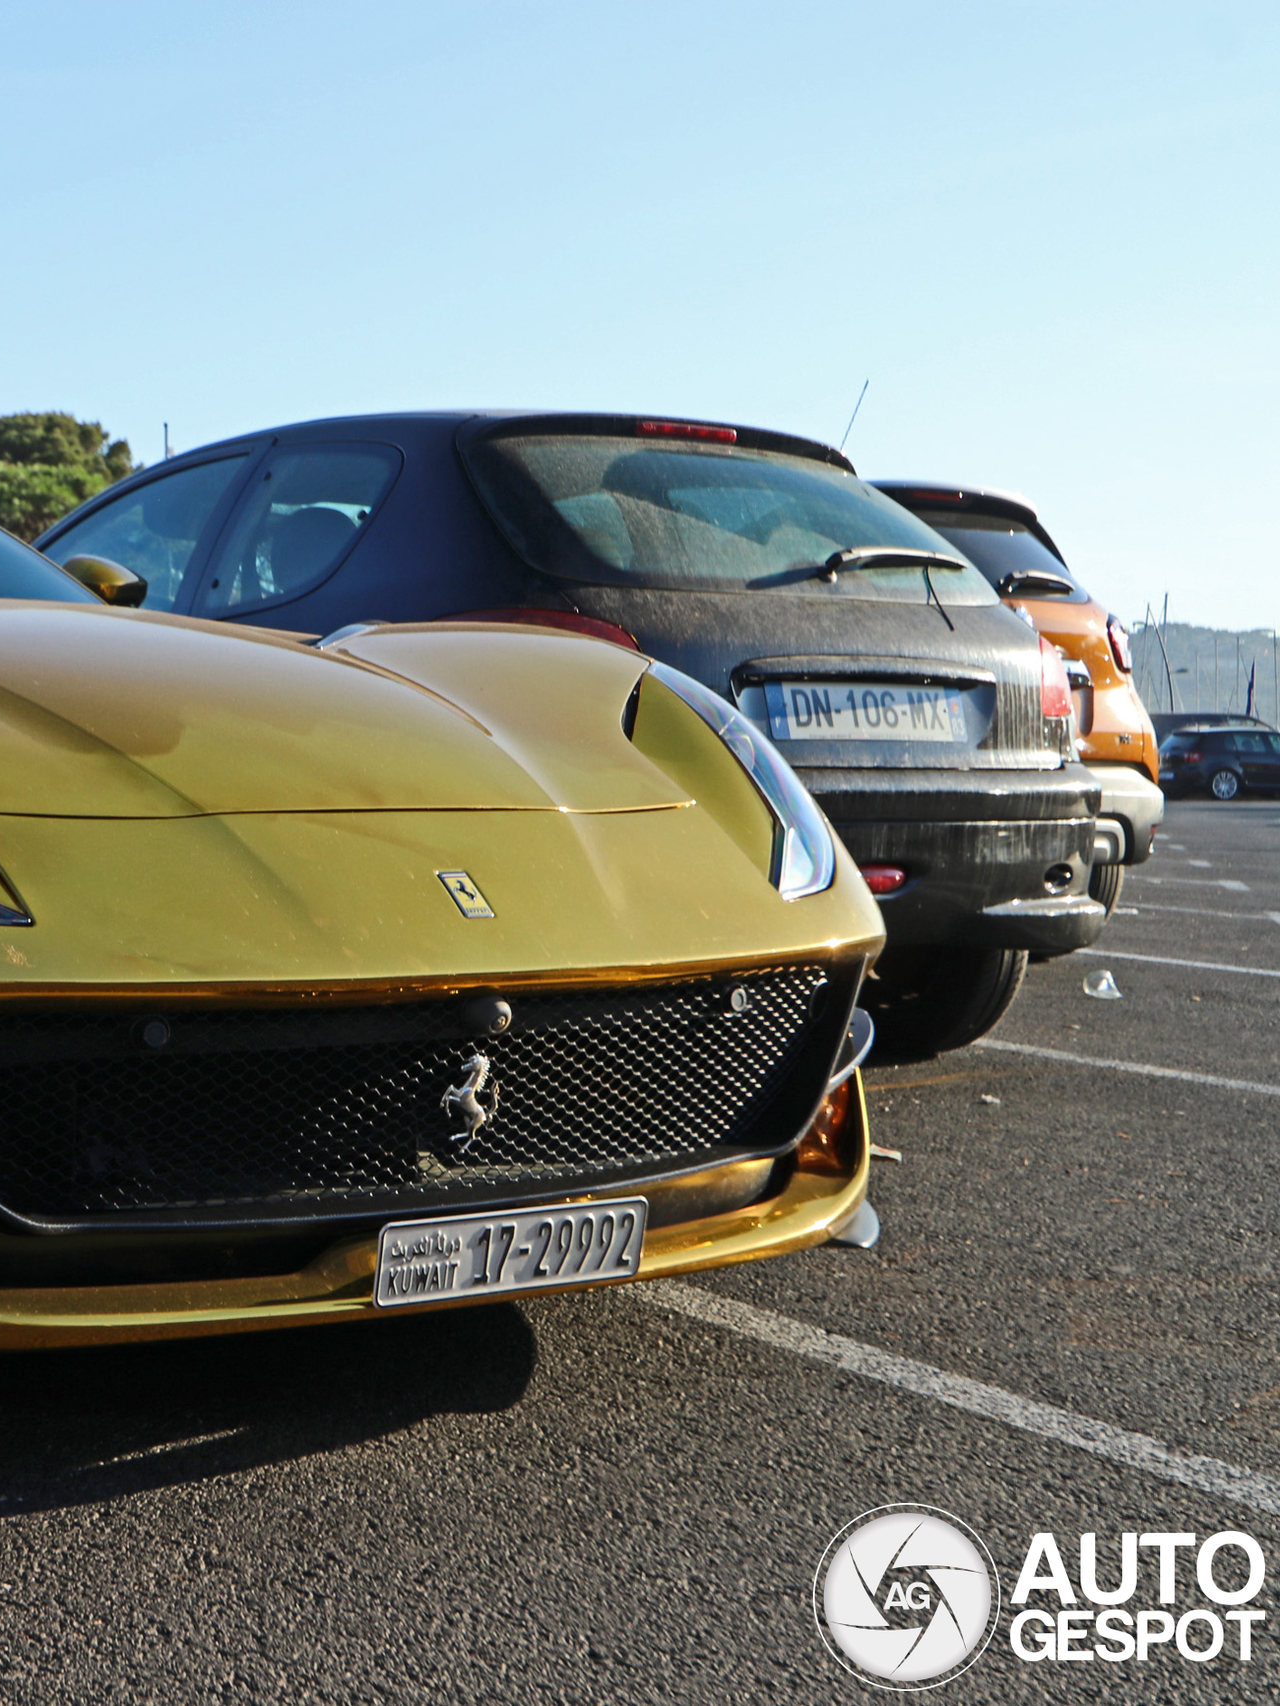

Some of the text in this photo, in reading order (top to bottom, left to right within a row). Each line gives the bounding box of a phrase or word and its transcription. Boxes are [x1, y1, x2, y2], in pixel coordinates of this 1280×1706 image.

[790, 688, 945, 731] DN-106-MX
[951, 717, 966, 736] 83
[472, 1208, 637, 1287] 17-29992
[387, 1259, 461, 1297] KUWAIT
